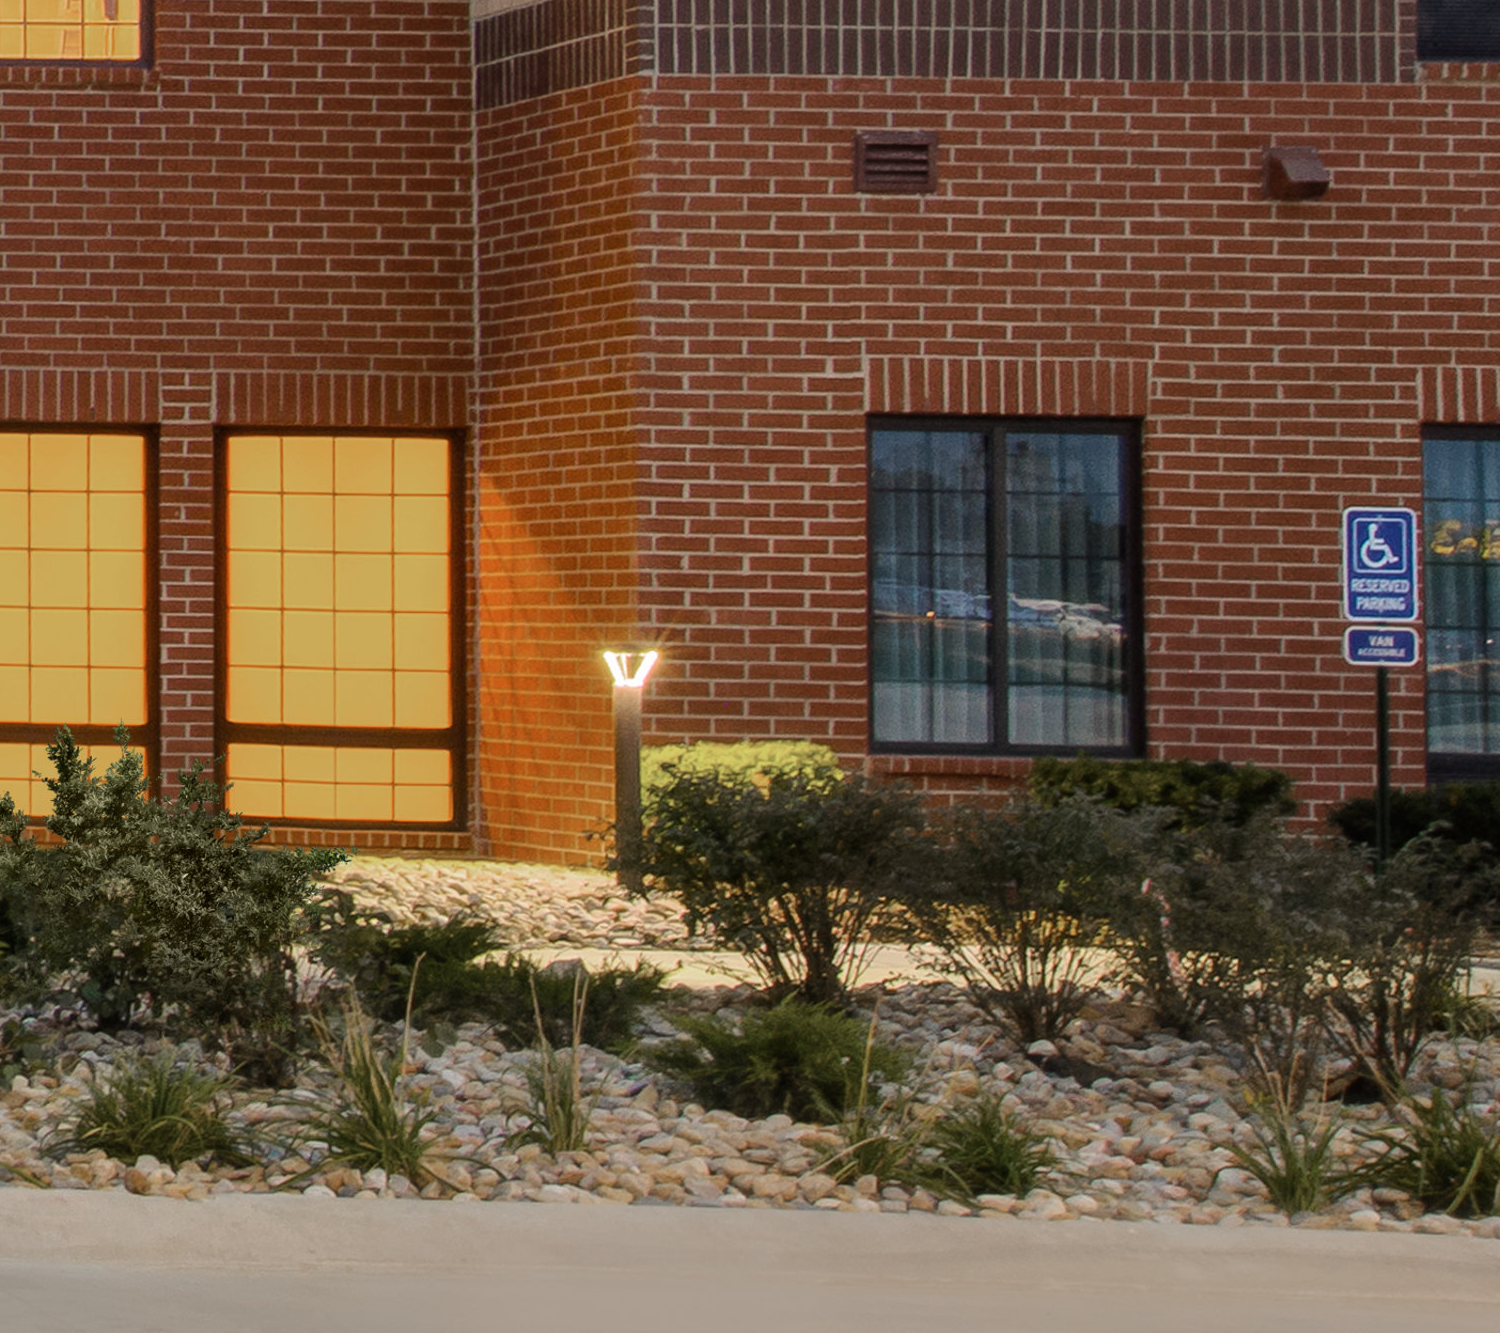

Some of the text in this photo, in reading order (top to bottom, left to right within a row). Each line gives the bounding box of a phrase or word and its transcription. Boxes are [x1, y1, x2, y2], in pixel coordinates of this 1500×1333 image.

[1351, 579, 1409, 593] RESERVED
[1356, 597, 1405, 611] PARKING
[1368, 636, 1394, 646] VAN
